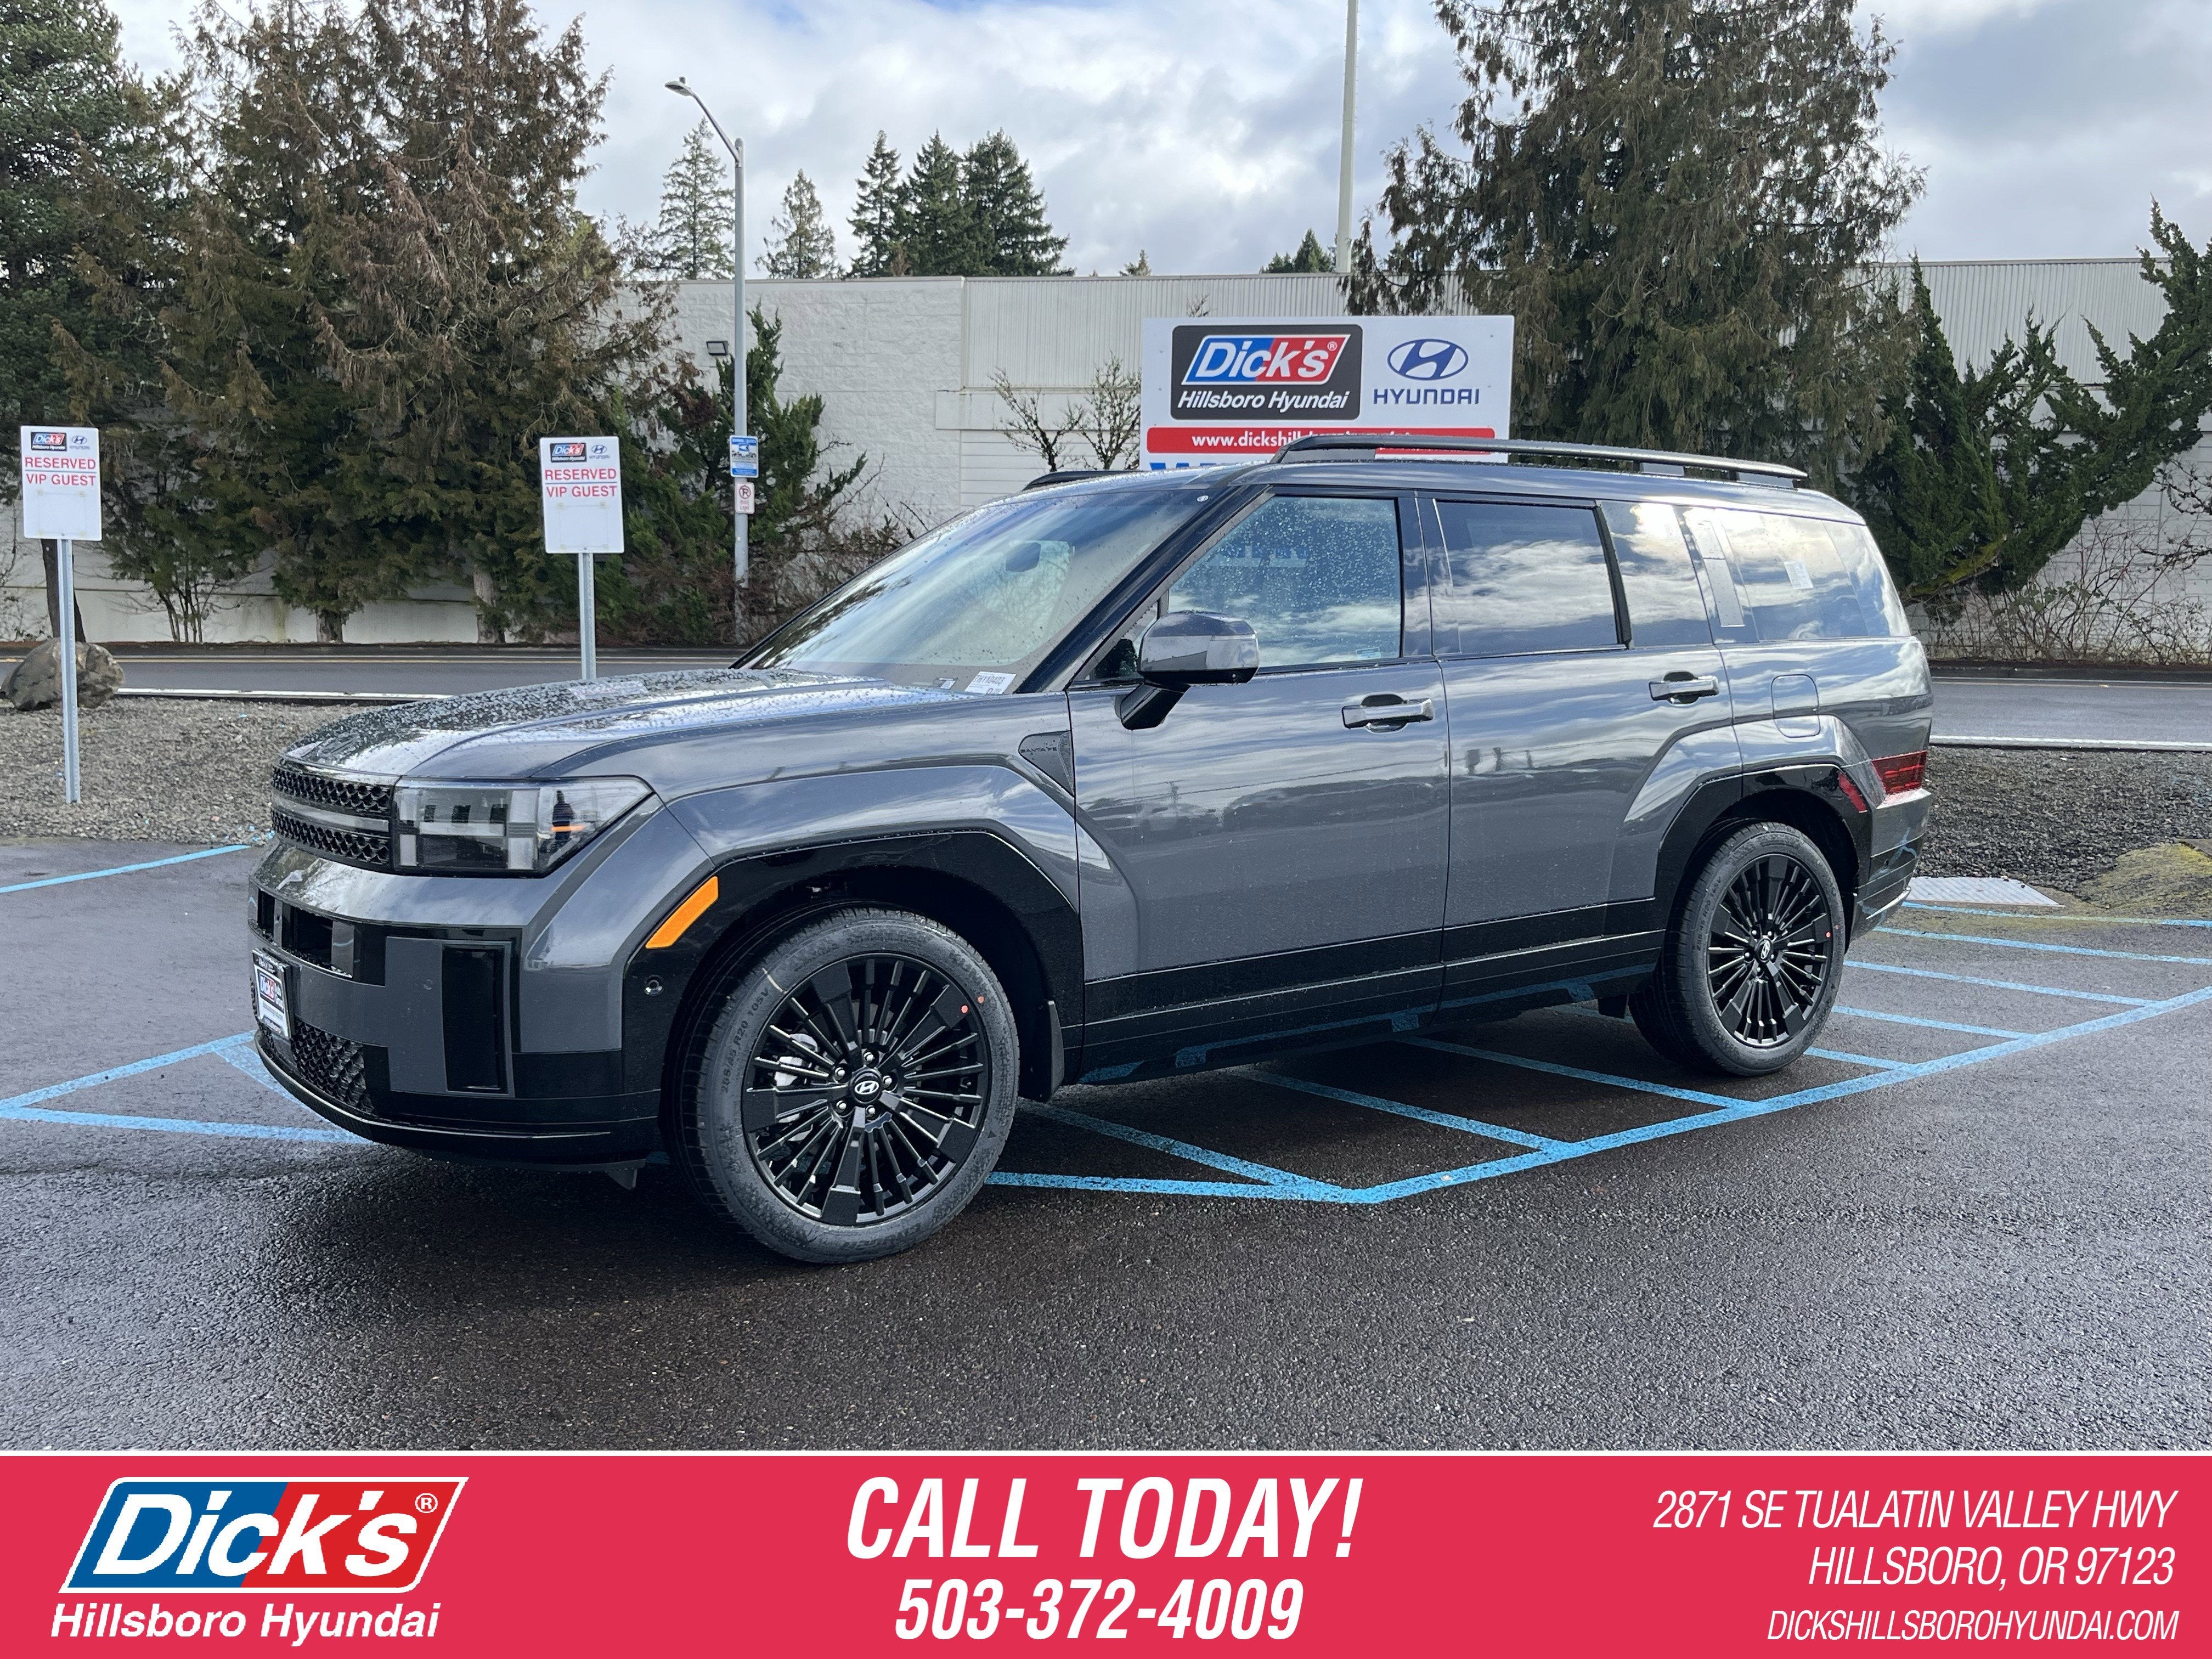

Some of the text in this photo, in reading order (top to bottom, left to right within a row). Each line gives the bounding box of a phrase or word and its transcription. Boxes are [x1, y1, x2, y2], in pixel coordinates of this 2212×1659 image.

[1195, 341, 1329, 378] Dick's
[1177, 391, 1350, 413] Hillsboro Hyundai
[1374, 388, 1480, 404] HYUNDAI
[25, 457, 96, 470] RESERVED
[26, 473, 96, 486] VIP GUEST
[545, 469, 617, 481] RESERVED
[546, 486, 617, 497] VIP GUEST
[733, 1020, 748, 1046] R20
[748, 988, 769, 1015] 105V
